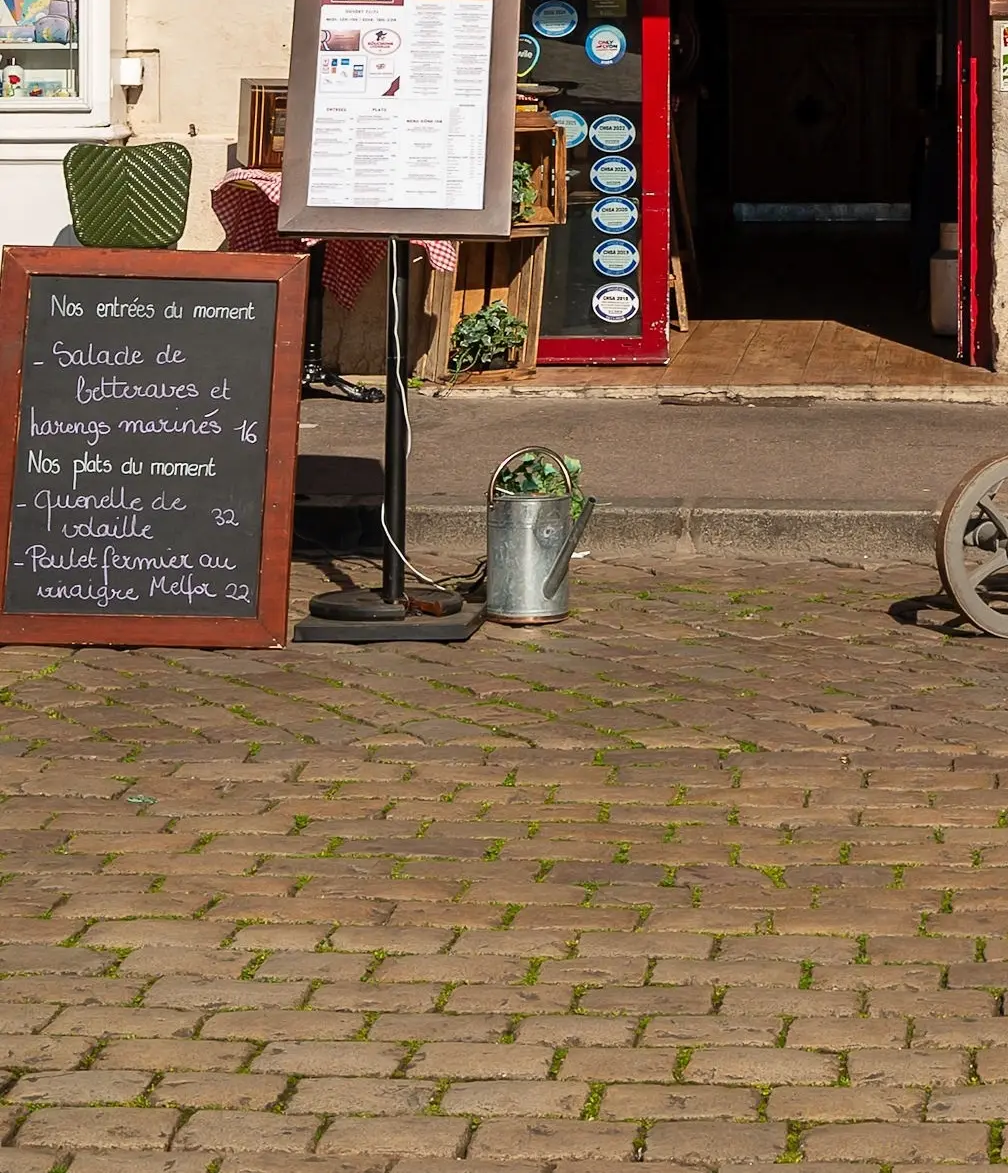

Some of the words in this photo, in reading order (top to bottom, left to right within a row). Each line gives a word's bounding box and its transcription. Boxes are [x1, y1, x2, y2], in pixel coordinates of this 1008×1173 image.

[50, 294, 84, 318] Nos
[96, 296, 156, 319] entrées
[163, 300, 183, 319] du
[192, 299, 256, 320] moment
[51, 341, 145, 367] Salade
[156, 344, 186, 365] de
[75, 377, 200, 404] betteraves
[210, 378, 232, 401] et
[29, 407, 111, 446] harengs
[118, 408, 223, 436] marinés
[233, 420, 258, 444] 16
[27, 450, 61, 475] Nos
[72, 451, 113, 491] plats
[121, 454, 143, 475] du
[150, 454, 217, 477] moment
[150, 490, 187, 512] de
[61, 514, 155, 540] volaille
[210, 508, 240, 527] 32
[24, 544, 99, 570] Poulet
[101, 547, 195, 584] fermier
[199, 552, 237, 570] au
[36, 581, 139, 608] vinaigre
[149, 575, 218, 605] Melfor
[225, 582, 252, 604] 22
